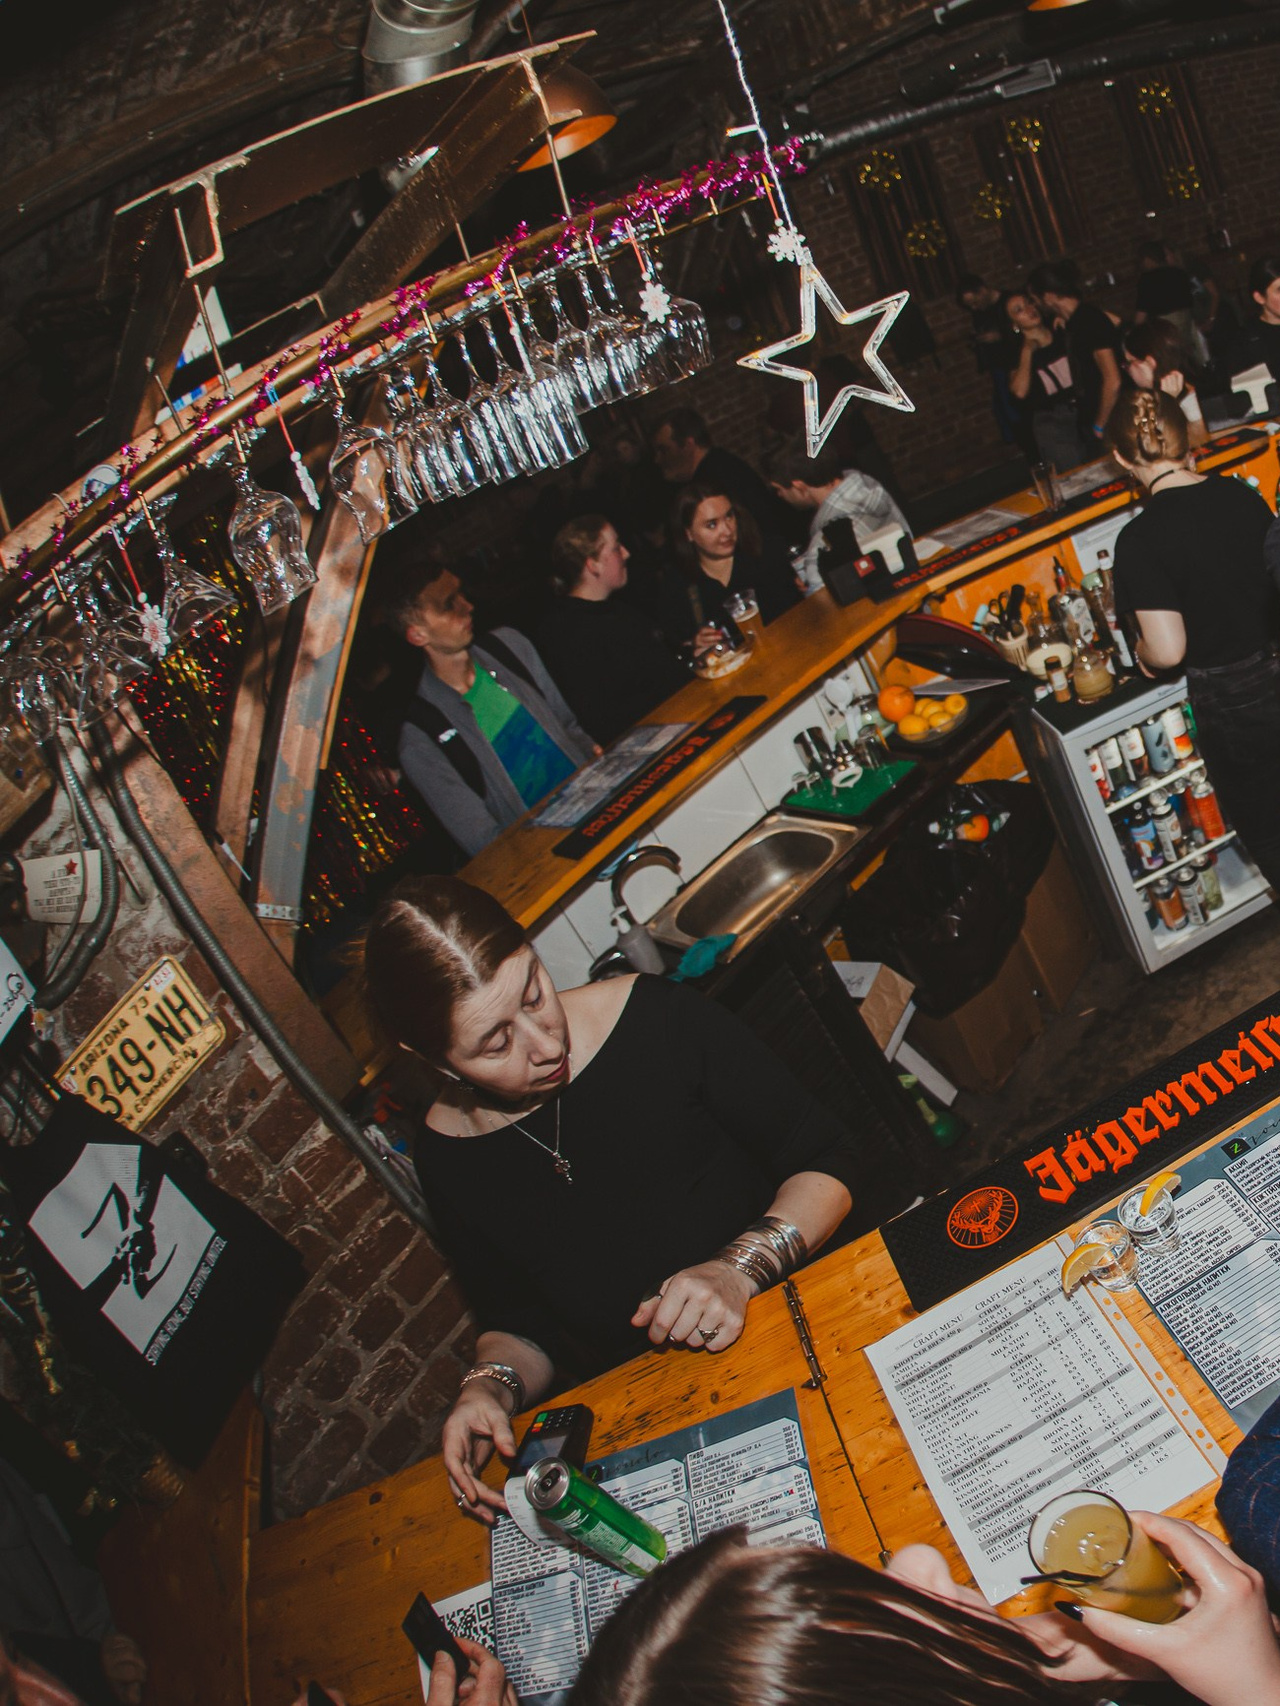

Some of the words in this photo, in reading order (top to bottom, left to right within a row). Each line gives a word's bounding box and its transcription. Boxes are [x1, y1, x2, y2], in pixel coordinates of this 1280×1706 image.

[77, 1016, 130, 1074] ARIZONA
[128, 994, 149, 1017] 73
[86, 983, 205, 1116] 349-NH
[133, 1043, 196, 1113] COMMERCIAL
[1228, 1158, 1248, 1174] АКЦИЯ
[186, 1261, 214, 1298] STAYING
[1158, 1281, 1203, 1313] АЛКОГОЛЬНЫЕ
[1201, 1264, 1230, 1286] НАПИТКИ
[1206, 1284, 1213, 1292] 40
[1212, 1279, 1221, 1288] МЛ
[178, 1293, 197, 1313] BUT
[912, 1328, 941, 1350] CRAFT
[939, 1313, 965, 1333] MENU
[974, 1290, 1002, 1311] CRAFT
[1001, 1275, 1027, 1295] MENU
[926, 1336, 945, 1350] BREW
[946, 1329, 957, 1338] 450
[1013, 1285, 1028, 1297] ALC
[1032, 1276, 1042, 1286] PL
[1182, 1307, 1190, 1315] 40
[1189, 1302, 1198, 1310] МЛ
[144, 1329, 172, 1365] STAYING
[899, 1383, 917, 1396] LOVE
[987, 1321, 1020, 1344] BERLINER
[1002, 1341, 1025, 1358] LAGER
[1192, 1348, 1203, 1358] РОМ
[1202, 1344, 1210, 1352] 40
[1209, 1339, 1218, 1347] МЛ
[1196, 1351, 1212, 1364] ДЖИН
[1217, 1341, 1227, 1350] МЛ
[1201, 1355, 1218, 1369] ТЕКИЛА
[1217, 1350, 1225, 1358] 40
[1224, 1345, 1234, 1354] МЛ
[891, 1360, 918, 1379] FAMILIA
[901, 1375, 917, 1387] NEW
[938, 1352, 957, 1366] BREW
[957, 1346, 968, 1355] 450
[905, 1392, 927, 1407] WHITE
[927, 1380, 948, 1394] MOON
[990, 1342, 1010, 1358] MILK
[1009, 1330, 1030, 1346] STOUT
[1205, 1358, 1227, 1375] САМБУКА
[1226, 1354, 1234, 1362] 40
[1233, 1349, 1242, 1357] МЛ
[1260, 1357, 1271, 1366] МЛ
[925, 1370, 953, 1389] CHERRY
[1026, 1377, 1044, 1391] DIPA
[911, 1400, 940, 1419] KOMETA
[939, 1393, 952, 1403] IPA
[917, 1415, 940, 1431] HEART
[940, 1409, 950, 1418] OF
[950, 1386, 991, 1412] MAKEDONIA
[923, 1401, 952, 1420] REWORT
[952, 1390, 972, 1404] BREW
[972, 1383, 984, 1392] 450
[950, 1419, 961, 1428] OF
[960, 1408, 980, 1422] LOVE
[1015, 1374, 1036, 1389] HAZY
[1035, 1367, 1048, 1378] IPA
[946, 1407, 969, 1422] MOOD
[937, 1456, 953, 1468] FIRE
[953, 1451, 961, 1459] IN
[962, 1443, 977, 1454] THE
[976, 1422, 1012, 1445] DARKNESS
[953, 1431, 968, 1442] NUT
[985, 1442, 1008, 1458] BREW
[1006, 1436, 1018, 1445] 450
[688, 1450, 704, 1460] ПИВО
[940, 1455, 969, 1475] BALKAN
[968, 1442, 991, 1458] PEARL
[985, 1458, 1010, 1475] DANCE
[694, 1498, 706, 1508] Б/А
[708, 1488, 736, 1503] НАПИТКИ
[955, 1477, 993, 1502] KISSBERRY
[959, 1482, 999, 1508] КИКИМОРА
[966, 1496, 1006, 1522] TANGERINE
[1006, 1482, 1030, 1498] CIDER
[970, 1495, 992, 1511] BREW
[991, 1475, 1026, 1498] BALANCE
[1024, 1469, 1037, 1479] 450
[1013, 1487, 1036, 1504] BREW
[1034, 1481, 1047, 1491] 450
[973, 1517, 1001, 1535] MANGO
[1000, 1503, 1024, 1519] CIDER
[977, 1522, 1007, 1542] CHERRY
[1007, 1508, 1031, 1525] STOUT
[987, 1520, 1026, 1545] ОРТОДОКС
